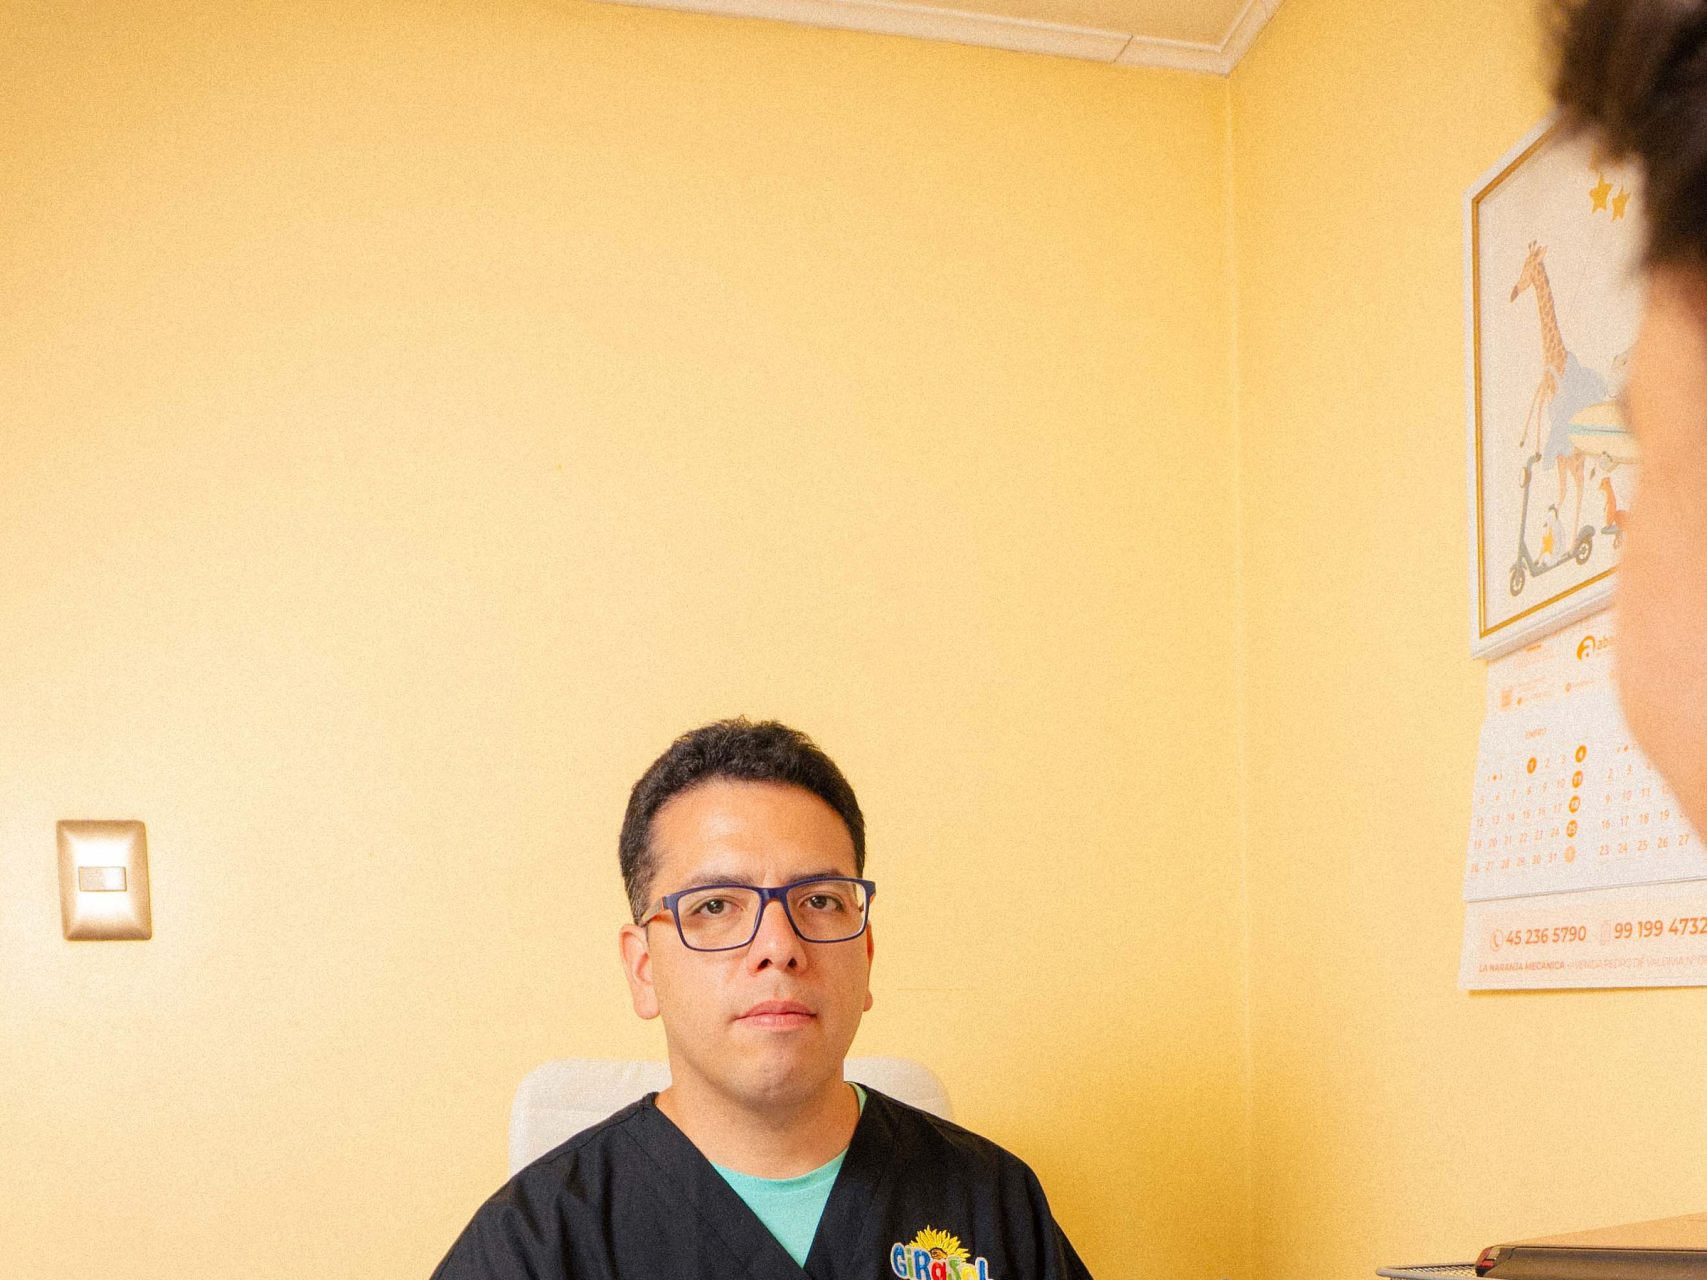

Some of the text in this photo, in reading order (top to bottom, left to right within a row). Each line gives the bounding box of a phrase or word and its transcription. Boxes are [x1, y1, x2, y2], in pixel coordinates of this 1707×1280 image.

[1641, 788, 1650, 798] 11
[1620, 815, 1630, 827] 17
[1639, 812, 1649, 825] 18
[1660, 809, 1670, 821] 19
[1599, 833, 1689, 856] 23 24 25 26 27
[1505, 925, 1587, 946] 45 236 5790
[1614, 916, 1707, 940] 99 199 4732
